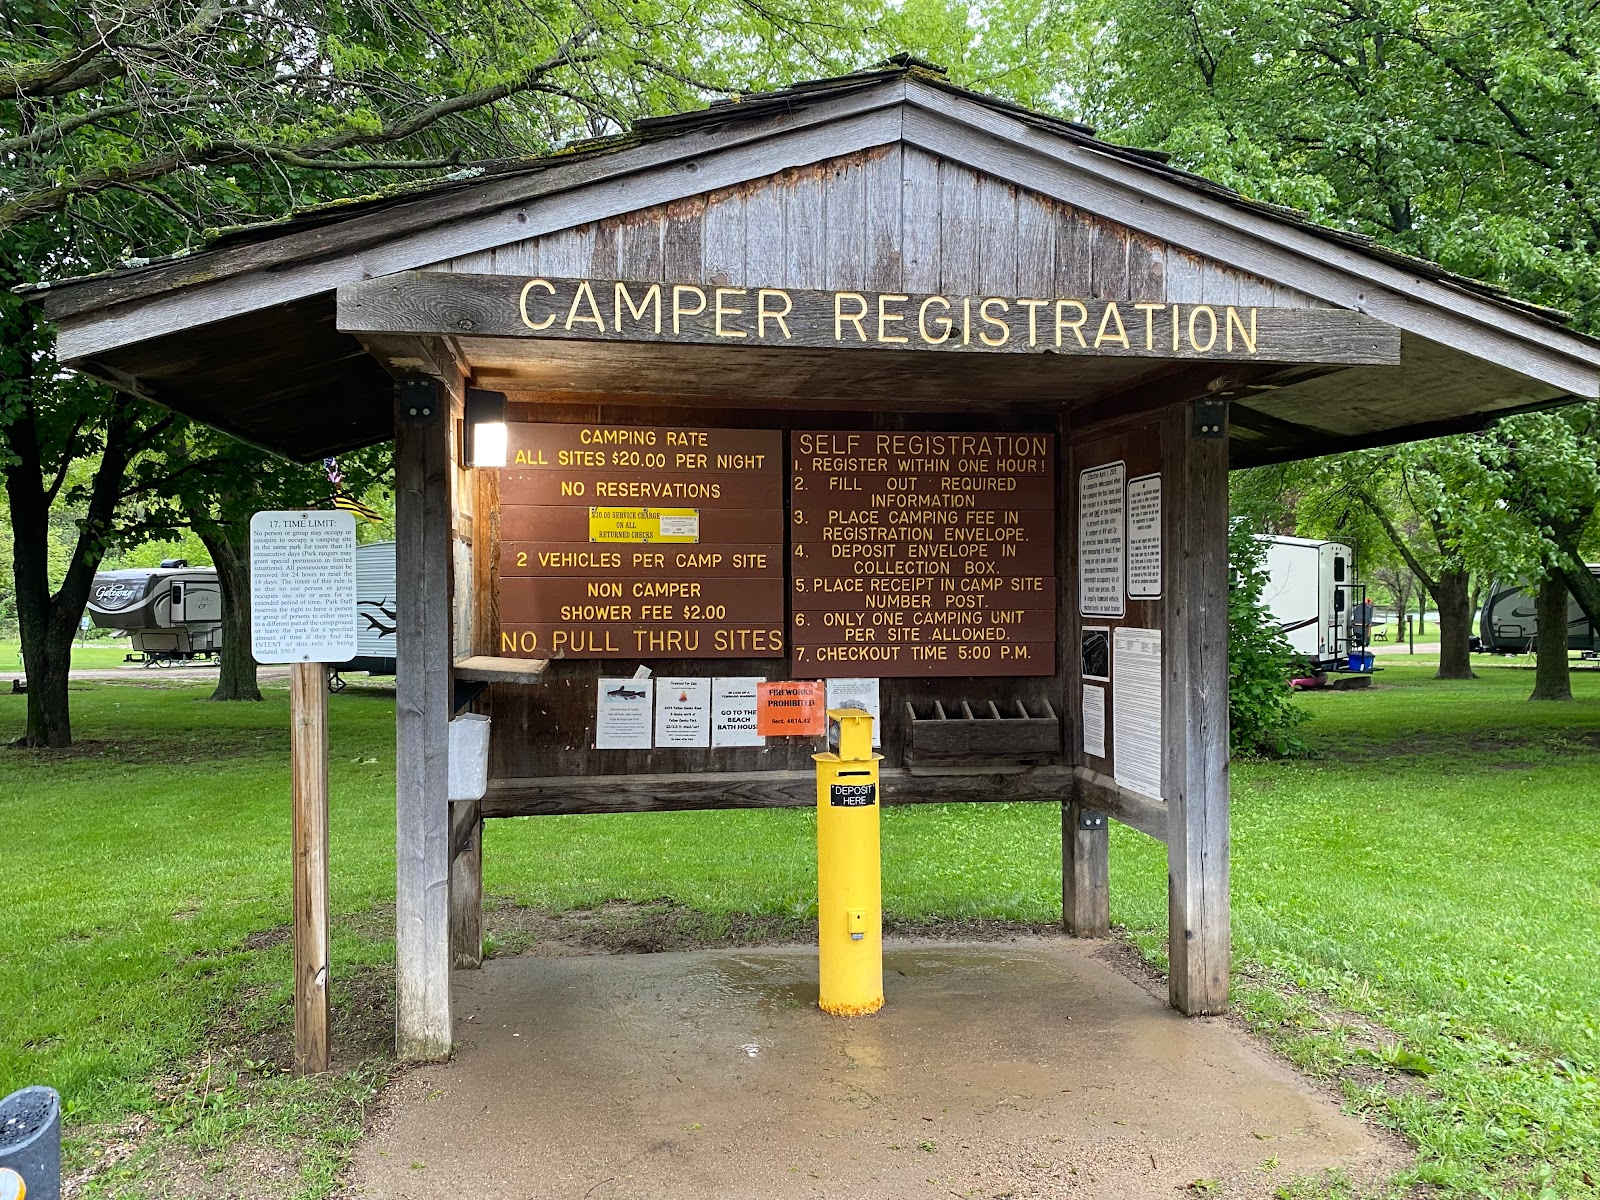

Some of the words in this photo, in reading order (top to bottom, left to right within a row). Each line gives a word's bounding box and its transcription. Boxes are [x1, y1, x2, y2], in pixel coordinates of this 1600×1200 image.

[519, 279, 793, 340] CAMPER
[834, 291, 1258, 354] REGISTRATION
[580, 430, 656, 445] CAMPING
[667, 432, 708, 447] RATE
[800, 435, 861, 455] SELF
[877, 437, 1046, 457] REGISTRATION
[515, 451, 548, 465] ALL
[558, 451, 605, 467] SITES
[612, 452, 666, 468] $20.00
[676, 454, 707, 468] PER
[717, 455, 765, 470] NIGHT
[795, 460, 803, 471] 1.
[813, 459, 887, 472] REGISTER
[897, 459, 950, 472] WITHIN
[959, 460, 988, 472] ONE
[997, 460, 1045, 473] HOUR!
[562, 482, 585, 497] NO
[597, 482, 721, 499] RESERVATIONS
[795, 478, 808, 491] 2.
[829, 477, 862, 491] FILL
[887, 478, 918, 491] OUT
[941, 478, 1017, 491] REQUIRED
[871, 494, 975, 508] INFORMATION
[283, 520, 306, 528] TIME
[309, 520, 337, 528] LIMIT:
[795, 511, 808, 524] 3.
[829, 511, 878, 525] PLACE
[889, 511, 958, 525] CAMPING
[966, 512, 994, 525] FEE
[1005, 512, 1019, 525] IN
[254, 537, 277, 545] conspire
[823, 528, 933, 541] REGISTRATION
[945, 528, 1029, 542] ENVELOPE.
[795, 545, 809, 558] 4.
[832, 545, 895, 558] DEPOSIT
[908, 545, 988, 558] ENVELOPE
[1002, 545, 1016, 557] IN
[517, 553, 527, 567] 2
[538, 552, 621, 568] VEHICLES
[633, 554, 664, 568] PER
[676, 554, 722, 568] CAMP
[733, 554, 767, 569] SITE
[854, 562, 950, 575] COLLECTION
[965, 562, 1000, 575] BOX.
[588, 583, 622, 597] NON
[632, 583, 701, 598] CAMPER
[796, 579, 809, 592] 5.
[814, 578, 864, 592] PLACE
[870, 578, 933, 591] RECEIPT
[941, 578, 955, 591] IN
[961, 578, 1003, 591] CAMP
[1011, 578, 1043, 591] SITE
[96, 583, 134, 603] Gateway
[865, 595, 931, 608] NUMBER
[946, 595, 988, 608] POST.
[561, 606, 632, 620] SHOWER
[642, 606, 673, 620] FEE
[683, 605, 726, 620] $2.00
[795, 613, 810, 626] 6.
[824, 613, 864, 626] ONLY
[873, 613, 903, 626] ONE
[913, 611, 982, 625] CAMPING
[991, 611, 1025, 624] UNIT
[502, 631, 537, 653] NO
[552, 631, 619, 652] PULL
[633, 630, 699, 651] THRU
[714, 630, 783, 651] SITES
[845, 629, 875, 642] PER
[888, 628, 920, 641] SITE
[931, 628, 1010, 641] ALLOWED.
[797, 648, 810, 662] 7.
[817, 647, 900, 661] CHECKOUT
[911, 647, 947, 660] TIME
[959, 646, 991, 659] 5:00
[1001, 645, 1031, 659] P.M.
[836, 786, 873, 795] DEPOSIT
[843, 796, 866, 805] HERE
